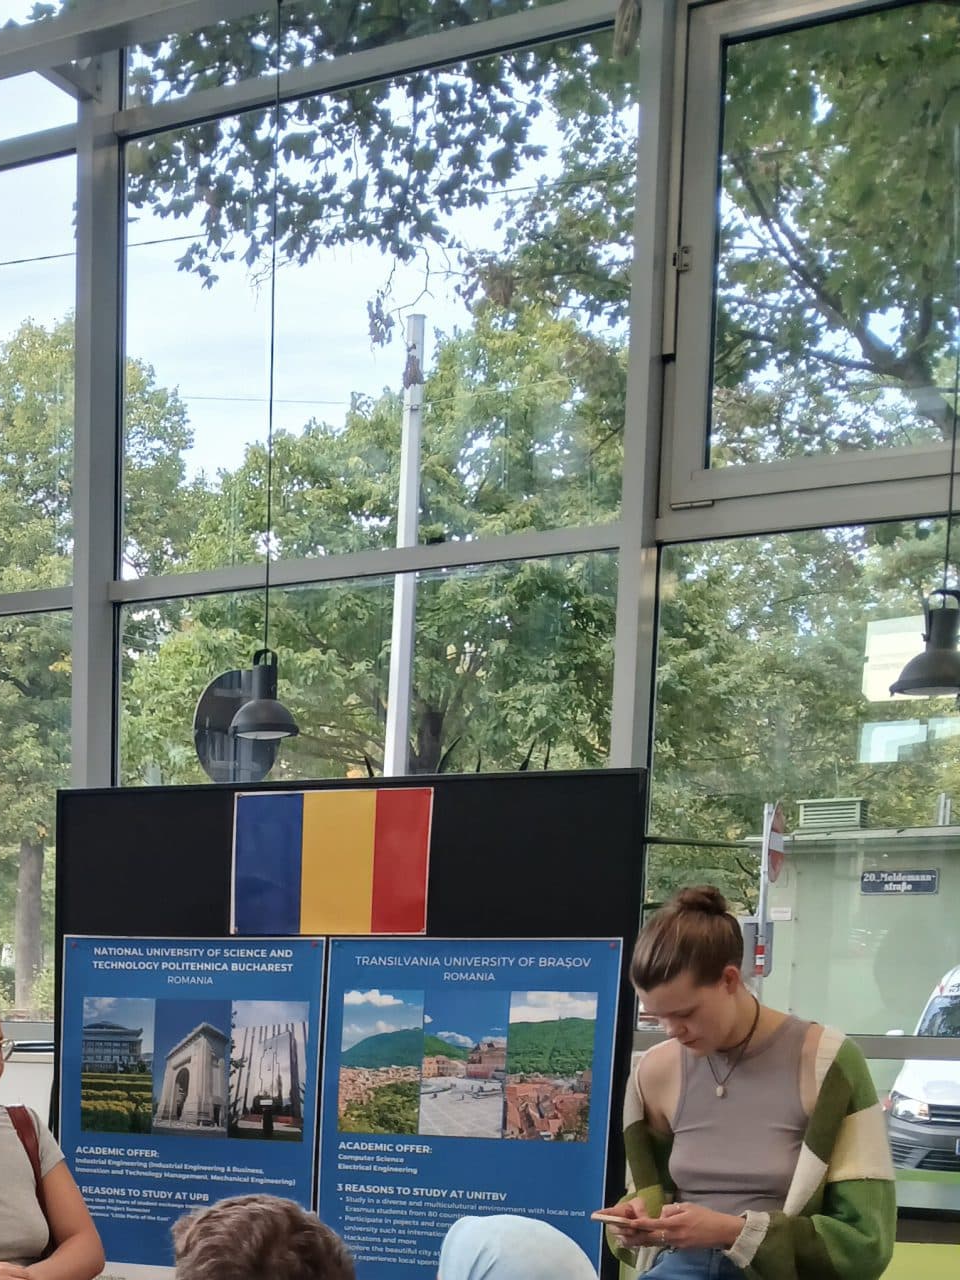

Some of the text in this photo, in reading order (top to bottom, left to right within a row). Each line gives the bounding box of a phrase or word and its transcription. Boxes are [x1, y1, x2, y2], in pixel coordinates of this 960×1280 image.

[884, 882, 912, 892] straße
[94, 946, 294, 958] NATIONAL UNIVERSITY OF SCIENCE AND
[92, 960, 293, 972] TECHNOLOGY POLITEHNICA BUCHAREST
[355, 956, 440, 966] TRANSILVANIA
[444, 956, 516, 967] UNIVERSITY
[518, 957, 535, 967] OF
[168, 976, 214, 984] ROMANIA
[443, 972, 496, 981] ROMANIA
[76, 1146, 160, 1158] ACADEMIC OFFER:
[338, 1142, 432, 1154] ACADEMIC OFFER:
[338, 1154, 404, 1163] Computer Science
[108, 1159, 148, 1168] Engineering
[149, 1161, 182, 1170] (Industrial
[184, 1164, 226, 1173] Engineering
[373, 1164, 418, 1174] Engineering
[125, 1169, 162, 1178] Technology
[210, 1174, 250, 1183] Mechanical
[82, 1186, 209, 1202] REASONS TO STUDY AT UPB
[336, 1184, 508, 1201] 3 REASONS TO STUDY AT UNITBV
[346, 1196, 366, 1204] Study
[382, 1198, 407, 1206] diverse
[546, 1208, 568, 1216] locals
[408, 1209, 426, 1217] from
[344, 1225, 378, 1234] university
